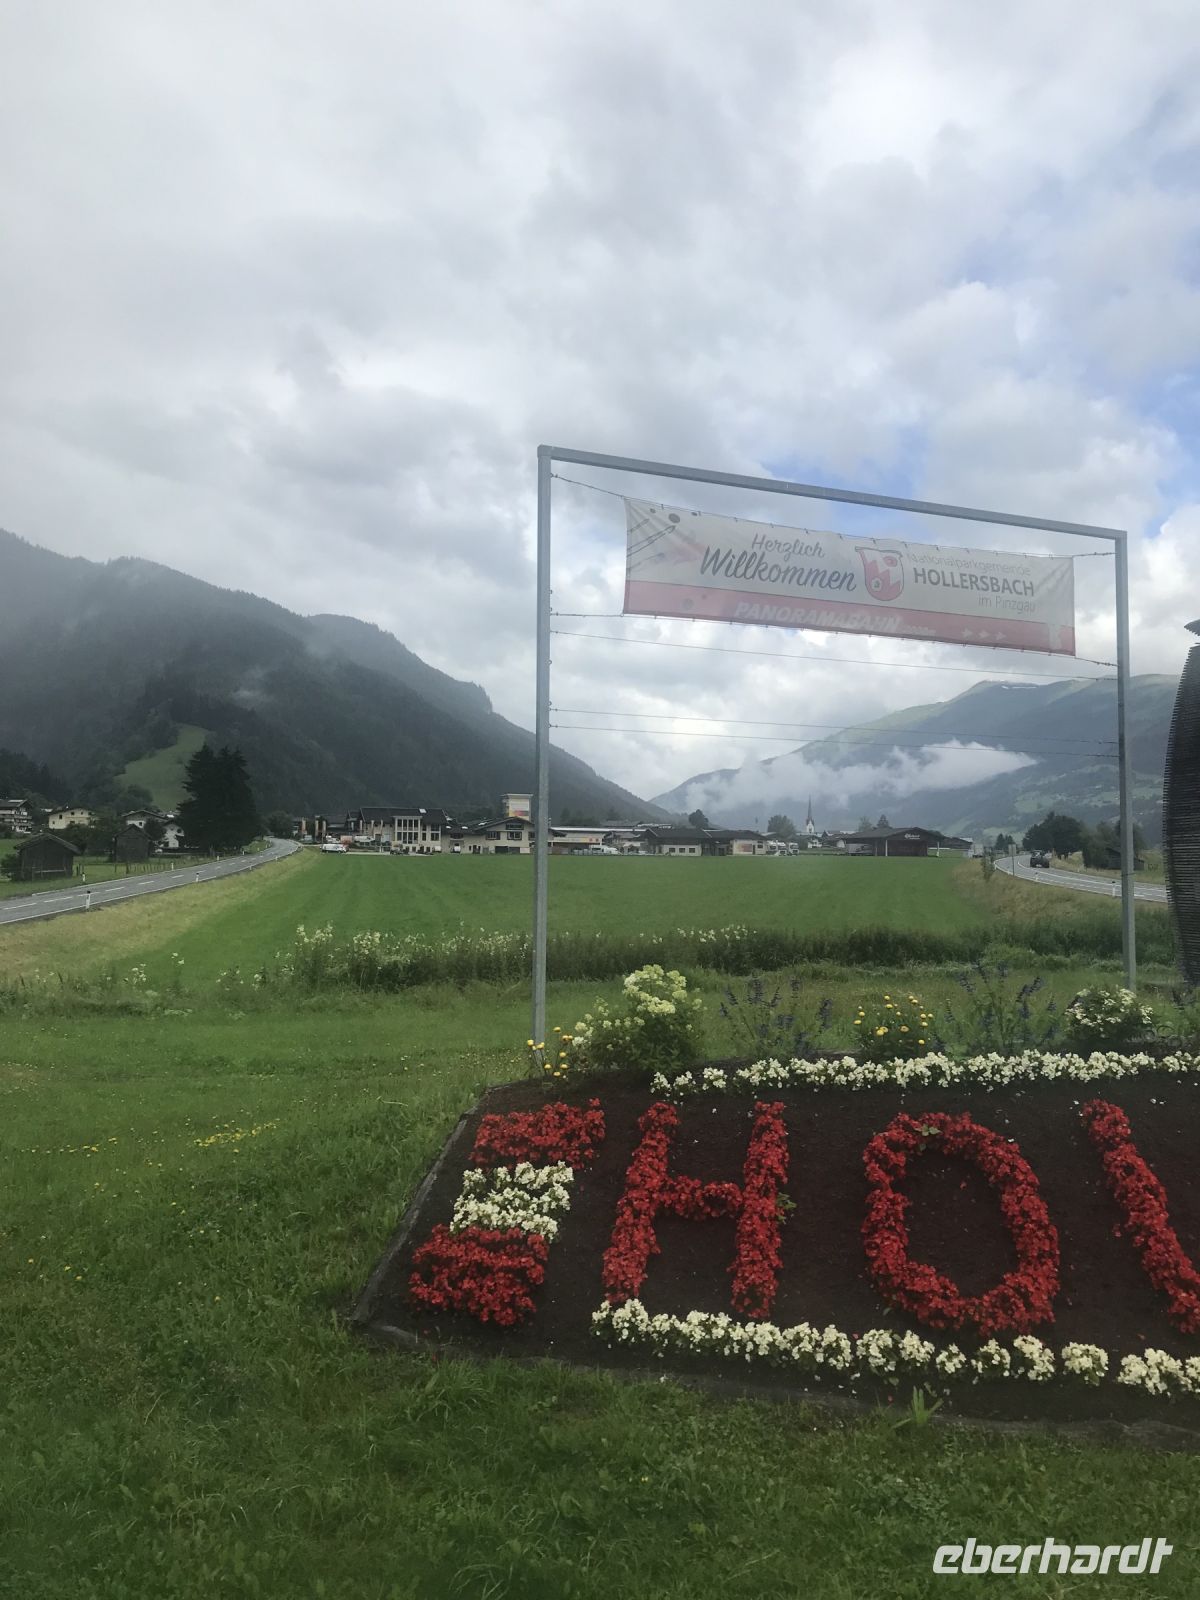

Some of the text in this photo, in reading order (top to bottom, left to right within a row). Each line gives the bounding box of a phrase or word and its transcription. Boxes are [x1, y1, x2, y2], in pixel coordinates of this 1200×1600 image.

[751, 532, 825, 561] Herzlich
[700, 545, 857, 592] Willkommen
[913, 567, 1035, 597] HOLLERSBACH
[734, 601, 903, 633] PANORAMABAHN
[977, 595, 1036, 616] im Pinzgau
